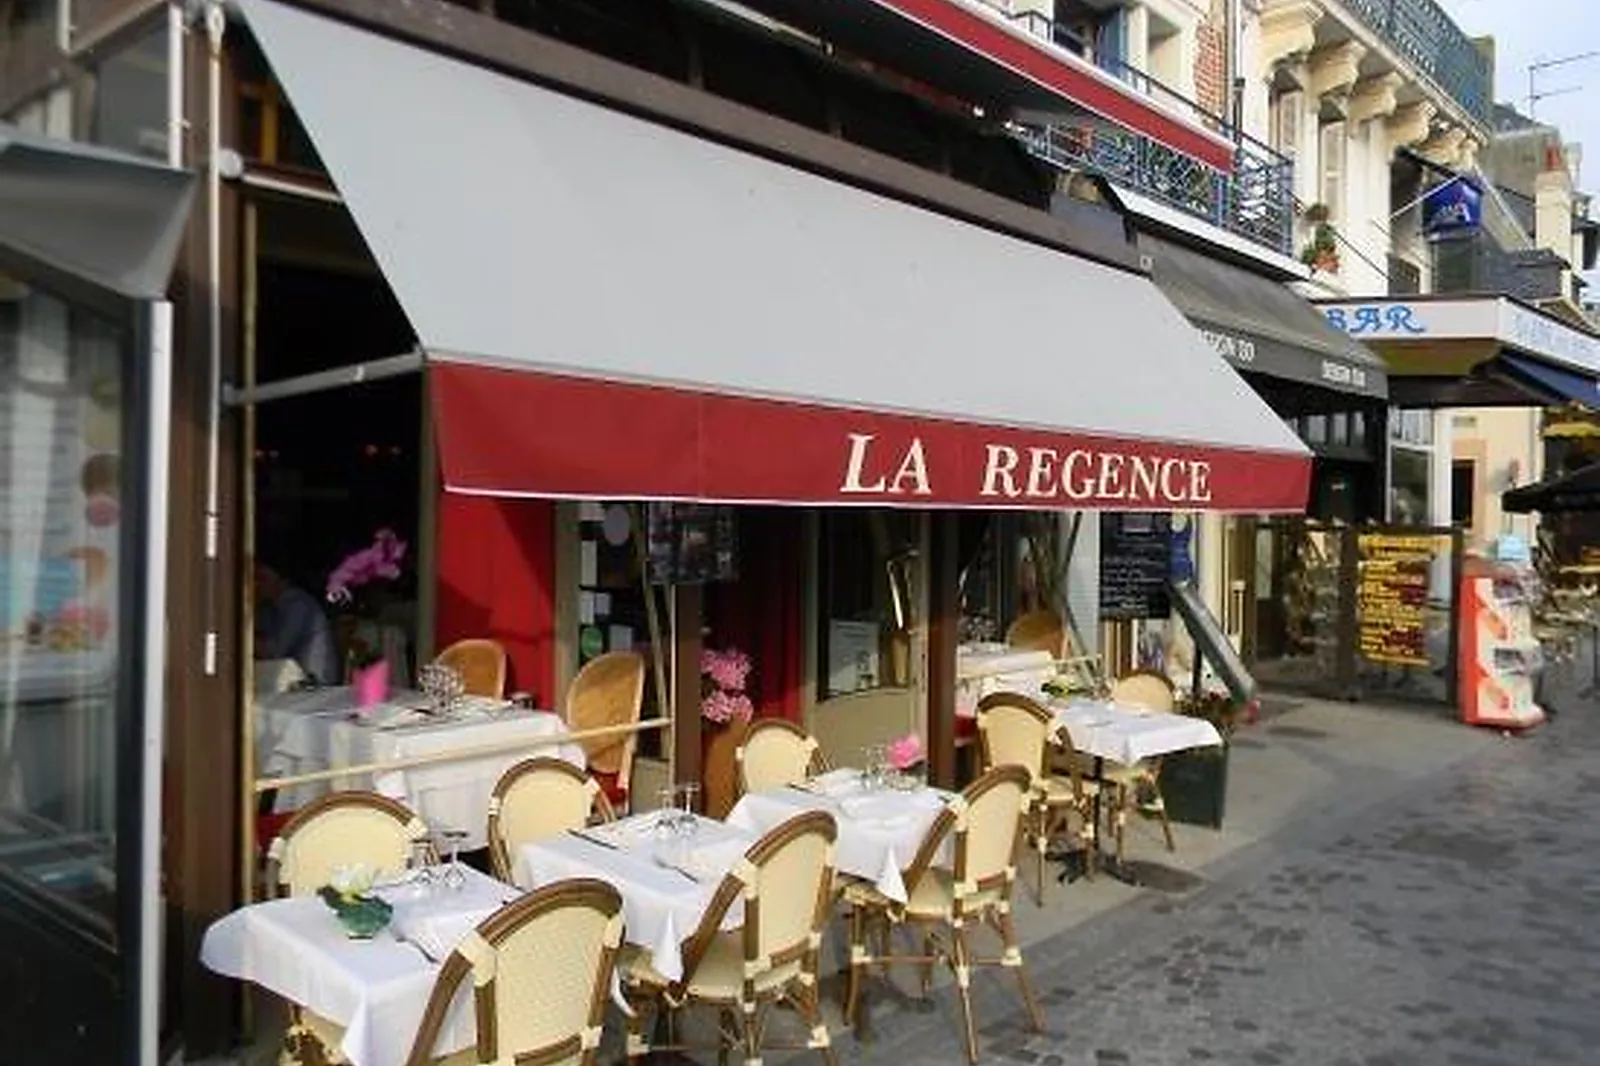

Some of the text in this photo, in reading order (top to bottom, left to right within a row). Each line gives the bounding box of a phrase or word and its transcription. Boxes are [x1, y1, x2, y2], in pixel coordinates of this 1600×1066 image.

[1325, 304, 1425, 333] BAR
[839, 433, 1212, 501] LA REGENCE
